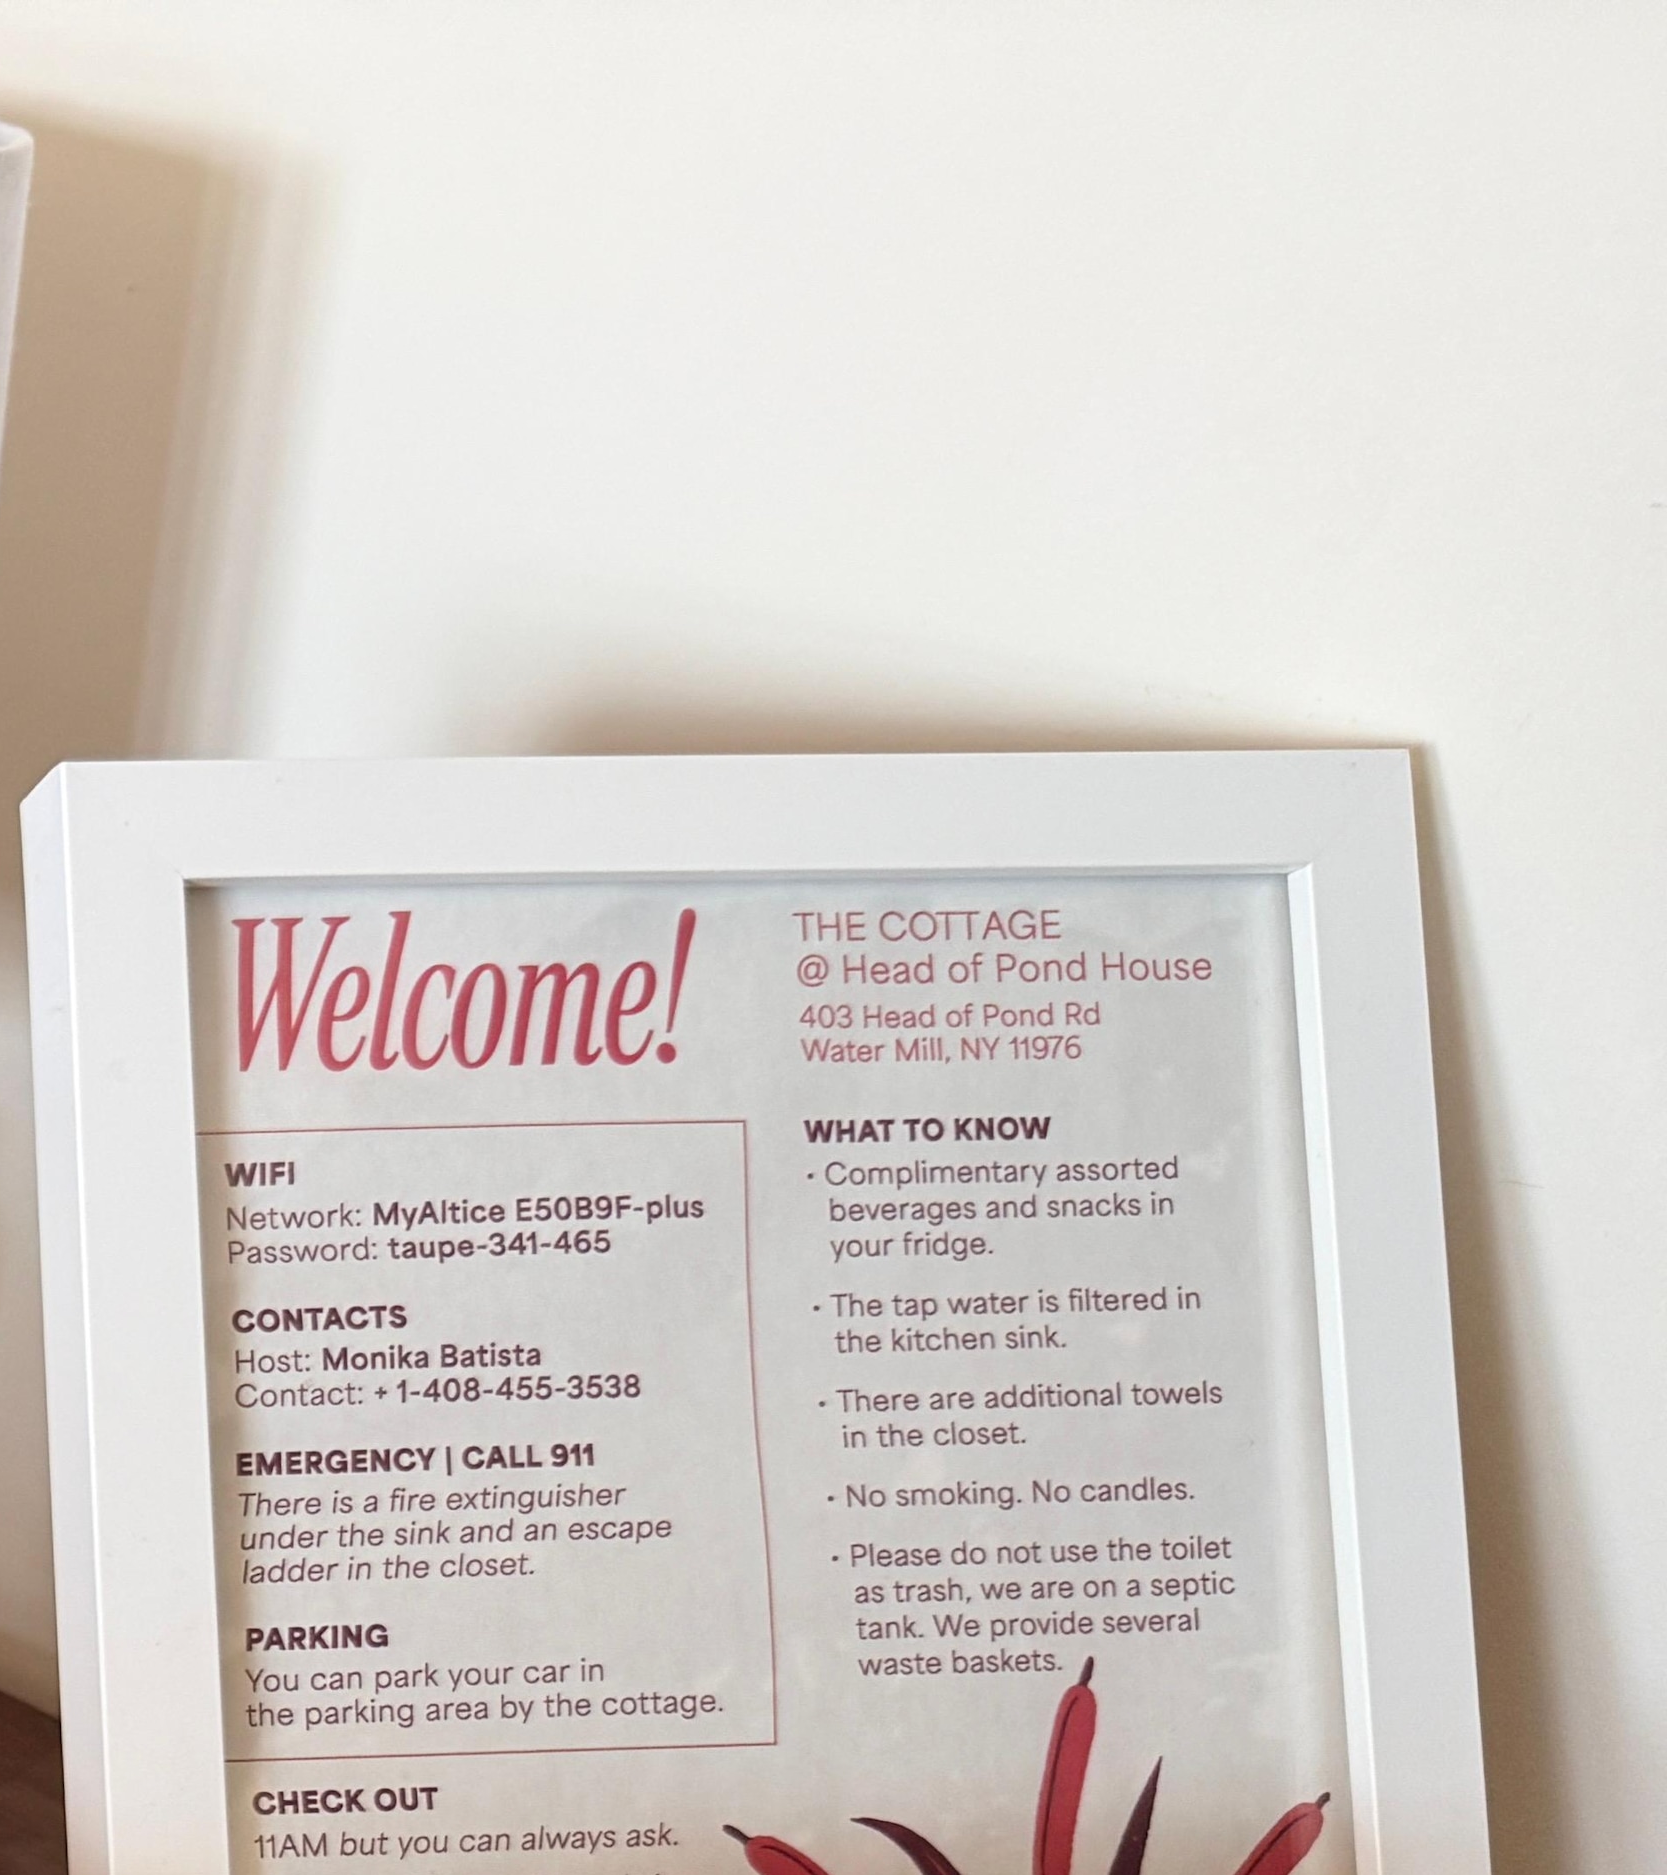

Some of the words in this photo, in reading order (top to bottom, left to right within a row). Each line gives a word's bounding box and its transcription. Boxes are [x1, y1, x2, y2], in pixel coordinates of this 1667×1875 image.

[792, 912, 866, 941] THE
[879, 910, 1061, 941] COTTAGE
[797, 954, 829, 987] @
[843, 954, 934, 984] Head
[948, 952, 983, 983] of
[996, 951, 1086, 982] Pond
[1102, 952, 1212, 981] House
[231, 908, 696, 1071] Welcome!
[800, 1004, 853, 1029] 403
[863, 1004, 936, 1028] Head
[946, 1003, 973, 1027] of
[983, 1002, 1054, 1027] Pond
[1066, 1002, 1100, 1025] Rd
[801, 1039, 885, 1063] Water
[895, 1037, 950, 1064] Mill,
[961, 1037, 1000, 1060] NY
[1009, 1035, 1082, 1060] 11976
[804, 1119, 895, 1143] WHAT
[903, 1118, 945, 1141] TO
[955, 1117, 1051, 1140] KNOW
[223, 1162, 294, 1187] WIFI
[825, 1160, 1047, 1190] Complimentary
[1057, 1155, 1178, 1182] assorted
[226, 1203, 362, 1231] Network:
[374, 1199, 505, 1231] MyAltice
[516, 1194, 704, 1224] E50B9F-plus
[830, 1198, 976, 1226] beverages
[987, 1194, 1037, 1219] and
[1047, 1193, 1141, 1218] snacks
[1151, 1191, 1174, 1215] in
[228, 1237, 378, 1264] Password:
[387, 1229, 611, 1263] taupe-341-465
[231, 1305, 407, 1333] CONTACTS
[235, 1350, 310, 1374] Host:
[323, 1345, 429, 1371] Monika
[441, 1342, 541, 1368] Batista
[836, 1389, 919, 1412] There
[930, 1392, 974, 1410] are
[985, 1382, 1121, 1409] additional
[1131, 1380, 1222, 1405] towels
[842, 1425, 866, 1448] in
[876, 1424, 923, 1447] the
[934, 1422, 1026, 1446] closet.
[846, 1485, 886, 1507] No
[896, 1481, 1022, 1510] smoking.
[1033, 1480, 1071, 1503] No
[1081, 1477, 1194, 1502] candles.
[245, 1624, 388, 1652] PARKING
[253, 1789, 366, 1815] CHECK
[374, 1787, 438, 1811] OUT
